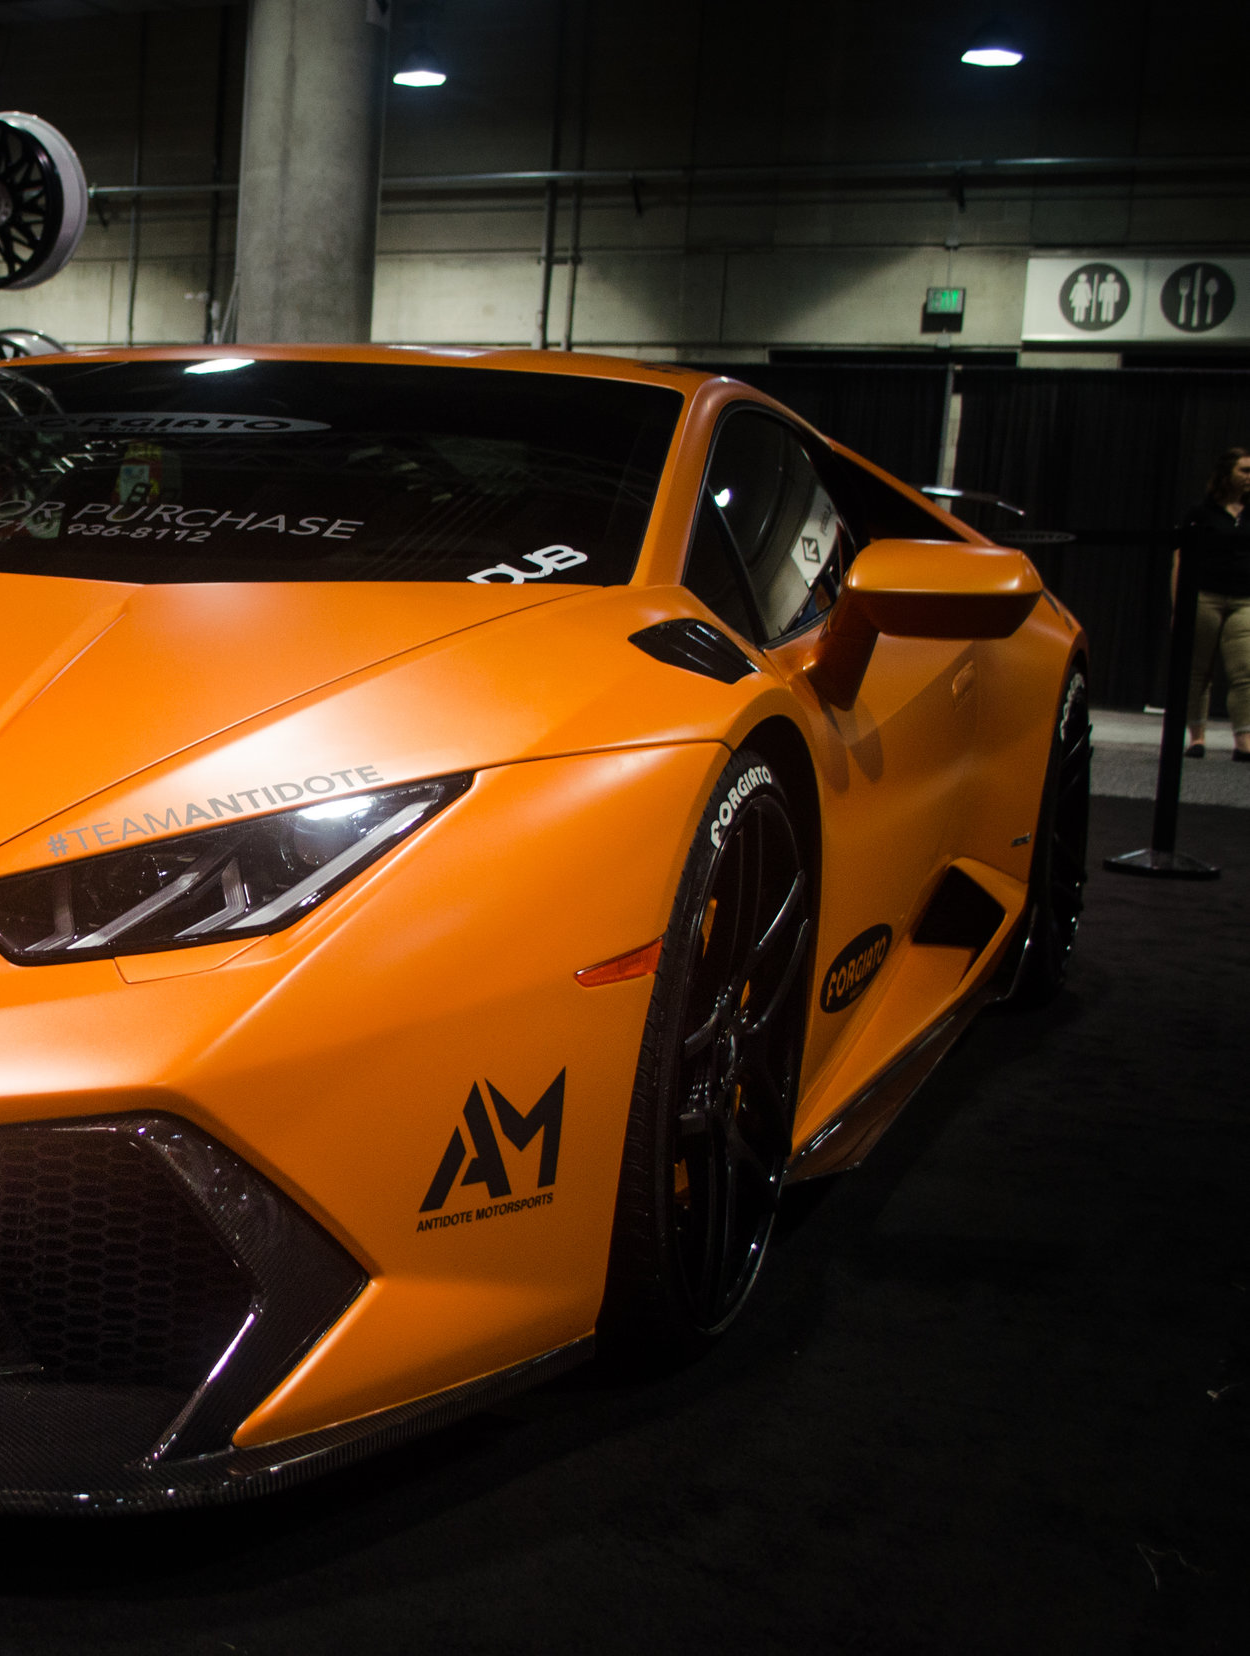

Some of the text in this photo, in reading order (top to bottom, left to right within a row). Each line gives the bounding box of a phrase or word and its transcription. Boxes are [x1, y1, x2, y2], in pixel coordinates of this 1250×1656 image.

[67, 523, 211, 543] 936-8112
[71, 503, 364, 540] PURCHASE
[466, 544, 588, 584] DUB
[47, 765, 384, 857] #TEAMANTIDOTE
[710, 766, 772, 849] FORGIATO
[826, 936, 887, 1007] FORGIATO
[419, 1065, 566, 1213] AM
[416, 1192, 553, 1233] ANTIDOTE MOTORSPORTS
